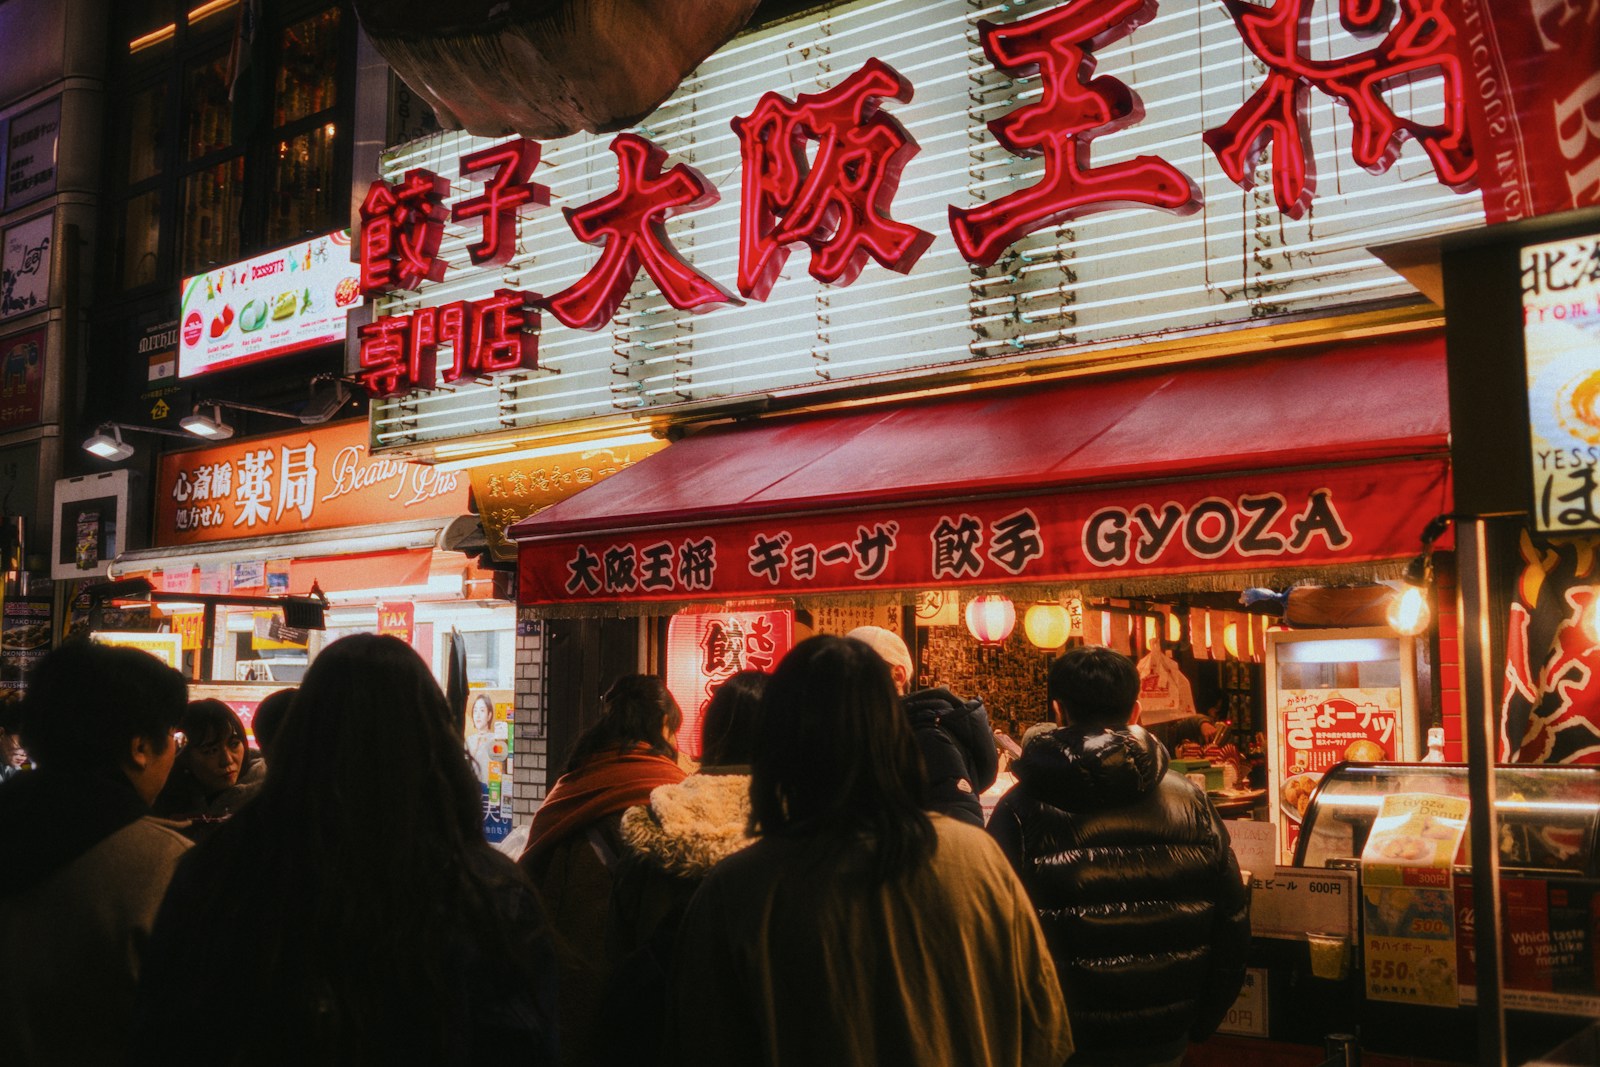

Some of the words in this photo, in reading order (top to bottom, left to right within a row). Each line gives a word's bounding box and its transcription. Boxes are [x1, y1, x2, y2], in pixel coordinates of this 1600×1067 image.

[542, 0, 1481, 331] 大阪王将
[360, 137, 551, 294] 餃子
[252, 259, 285, 281] DESSERTS
[137, 329, 178, 354] MITHIL
[356, 288, 543, 398] 専門店
[172, 461, 232, 502] 心斎橋
[234, 440, 317, 527] 薬局
[175, 505, 225, 530] 処方せん
[565, 536, 716, 595] 大阪王将
[747, 520, 899, 586] ギョーザ
[929, 507, 1044, 579] 餃子
[1081, 487, 1354, 567] GYOZA
[381, 612, 406, 627] TAX
[1286, 703, 1395, 750] ぎょーナツ
[1419, 806, 1464, 821] Donut
[1251, 878, 1298, 891] 生ビール
[1309, 881, 1341, 895] 600円
[1370, 940, 1434, 954] 角ハイボール
[1511, 929, 1551, 945] Which
[1518, 945, 1534, 956] do
[1536, 944, 1558, 957] you
